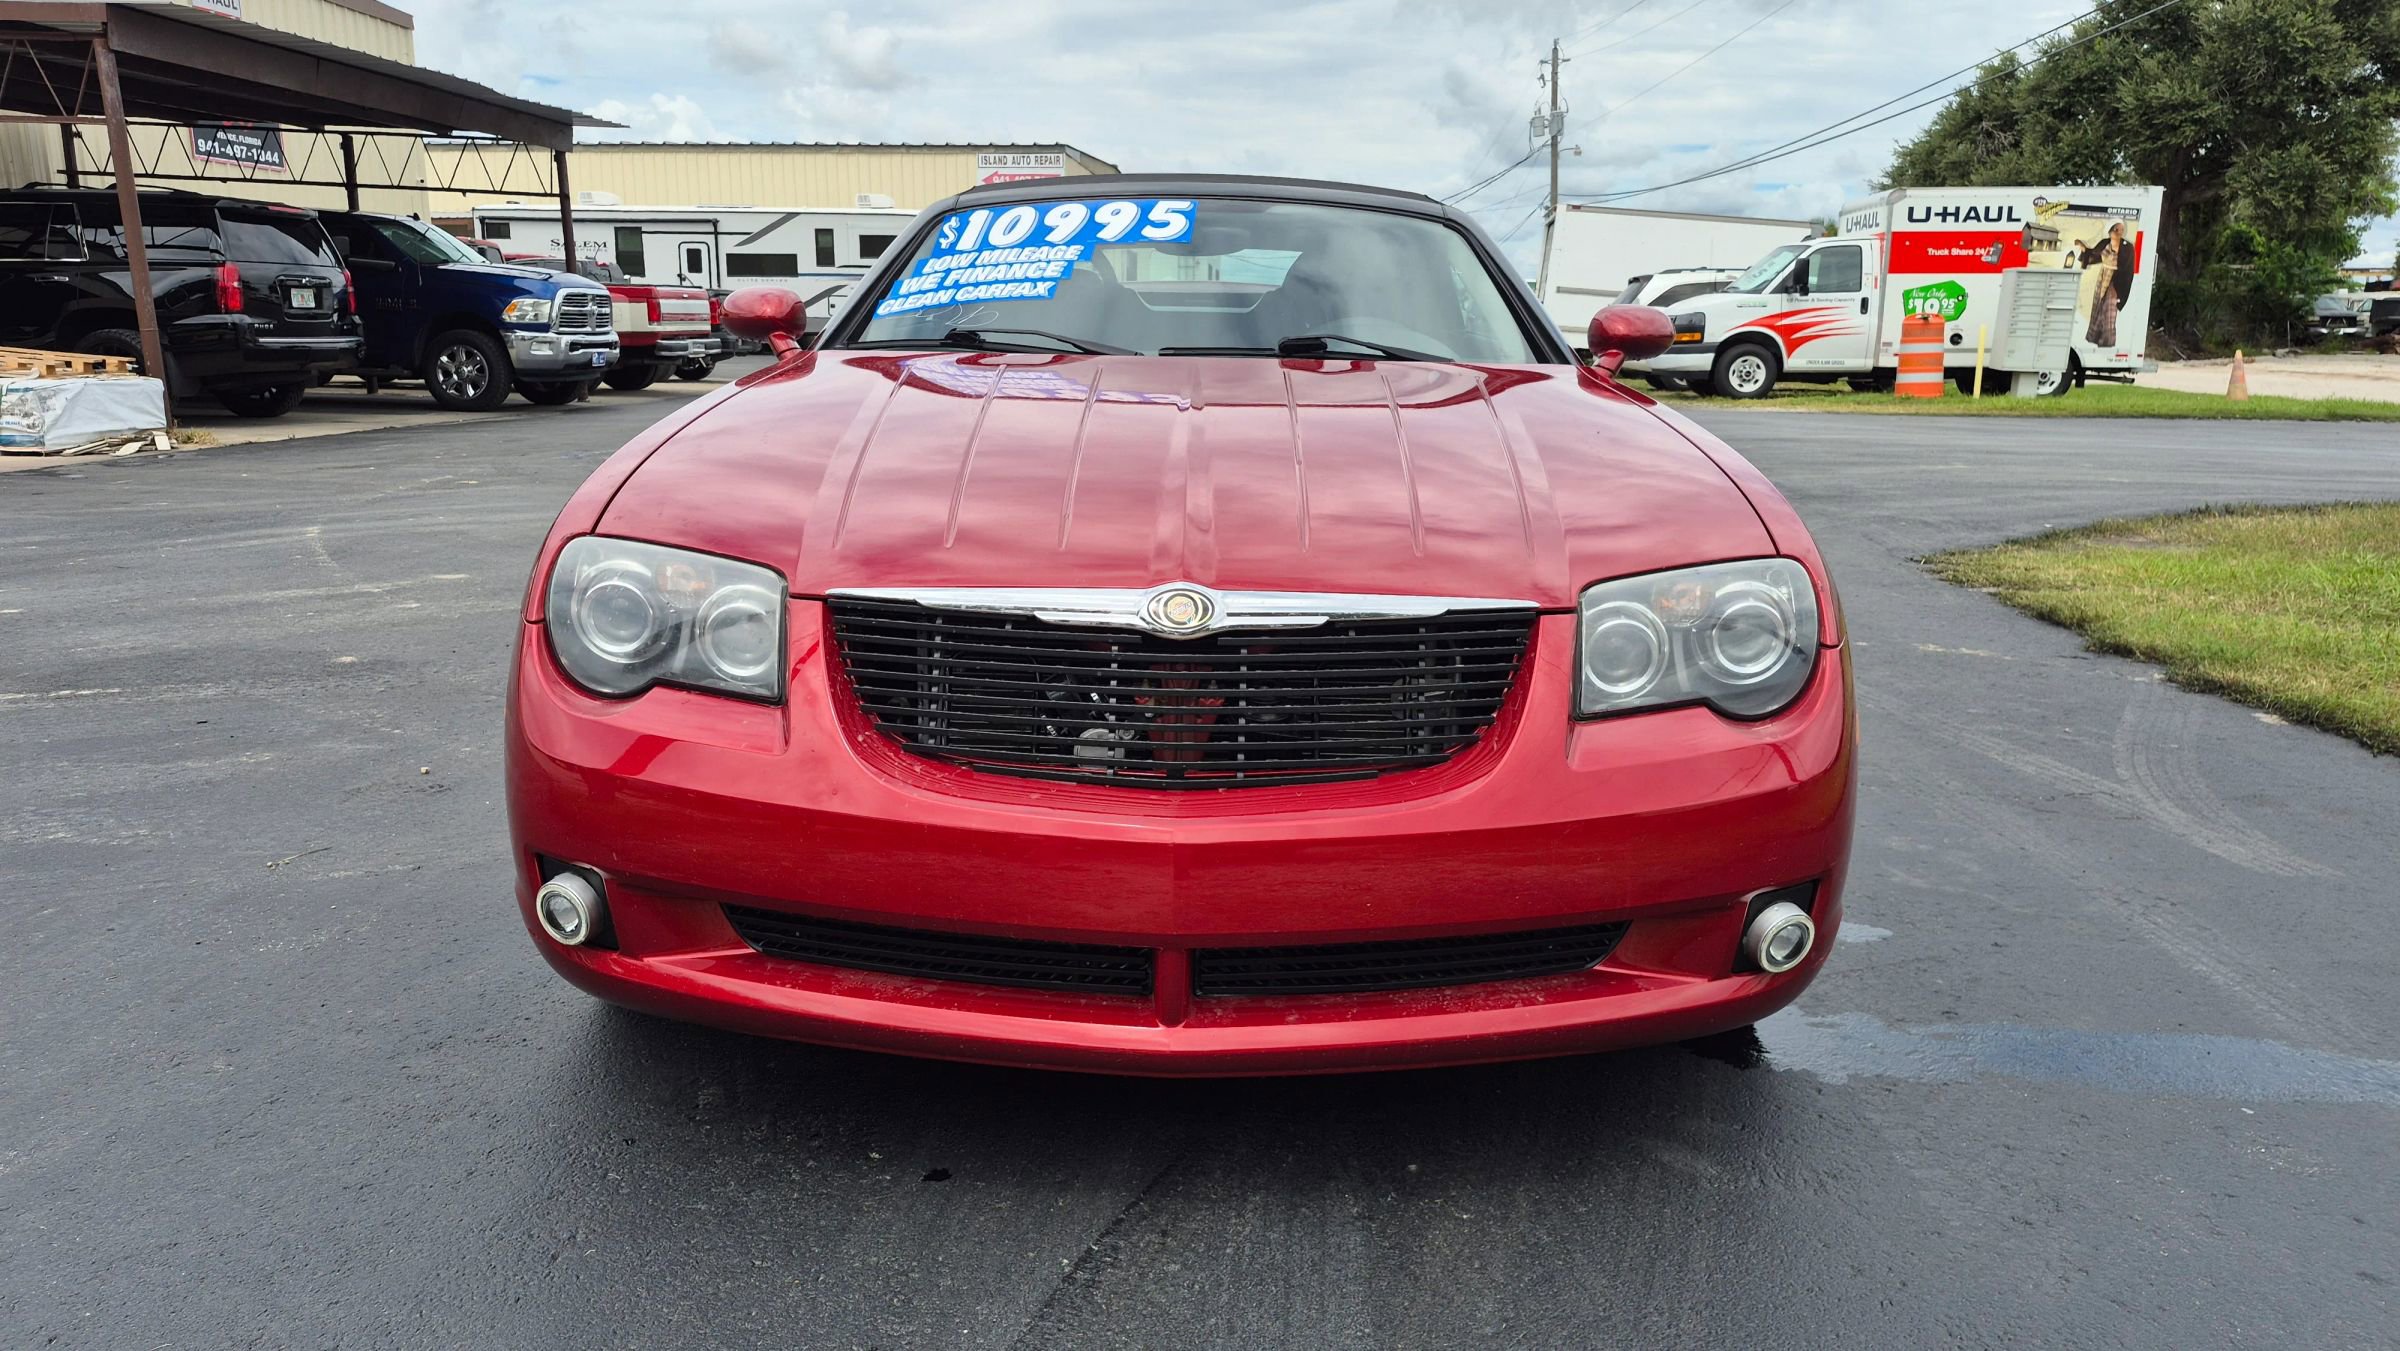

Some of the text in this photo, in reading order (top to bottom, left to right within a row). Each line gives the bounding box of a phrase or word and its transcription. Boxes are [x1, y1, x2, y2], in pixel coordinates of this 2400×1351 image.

[980, 155, 1061, 166] ISLAND AUTO REPAIR
[1907, 206, 2021, 223] U-HAUL
[2107, 207, 2138, 216] ONTARIO
[939, 201, 1194, 251] $10995
[1846, 211, 1880, 233] U-HAUL
[550, 239, 607, 248] SEM
[1927, 247, 1949, 256] Truck
[1951, 247, 1974, 256] Share
[923, 245, 1084, 274] LOW MILEAGE
[899, 261, 1068, 295] WE FINANCE
[877, 289, 955, 316] CLEAN
[955, 281, 1056, 301] CARFAX
